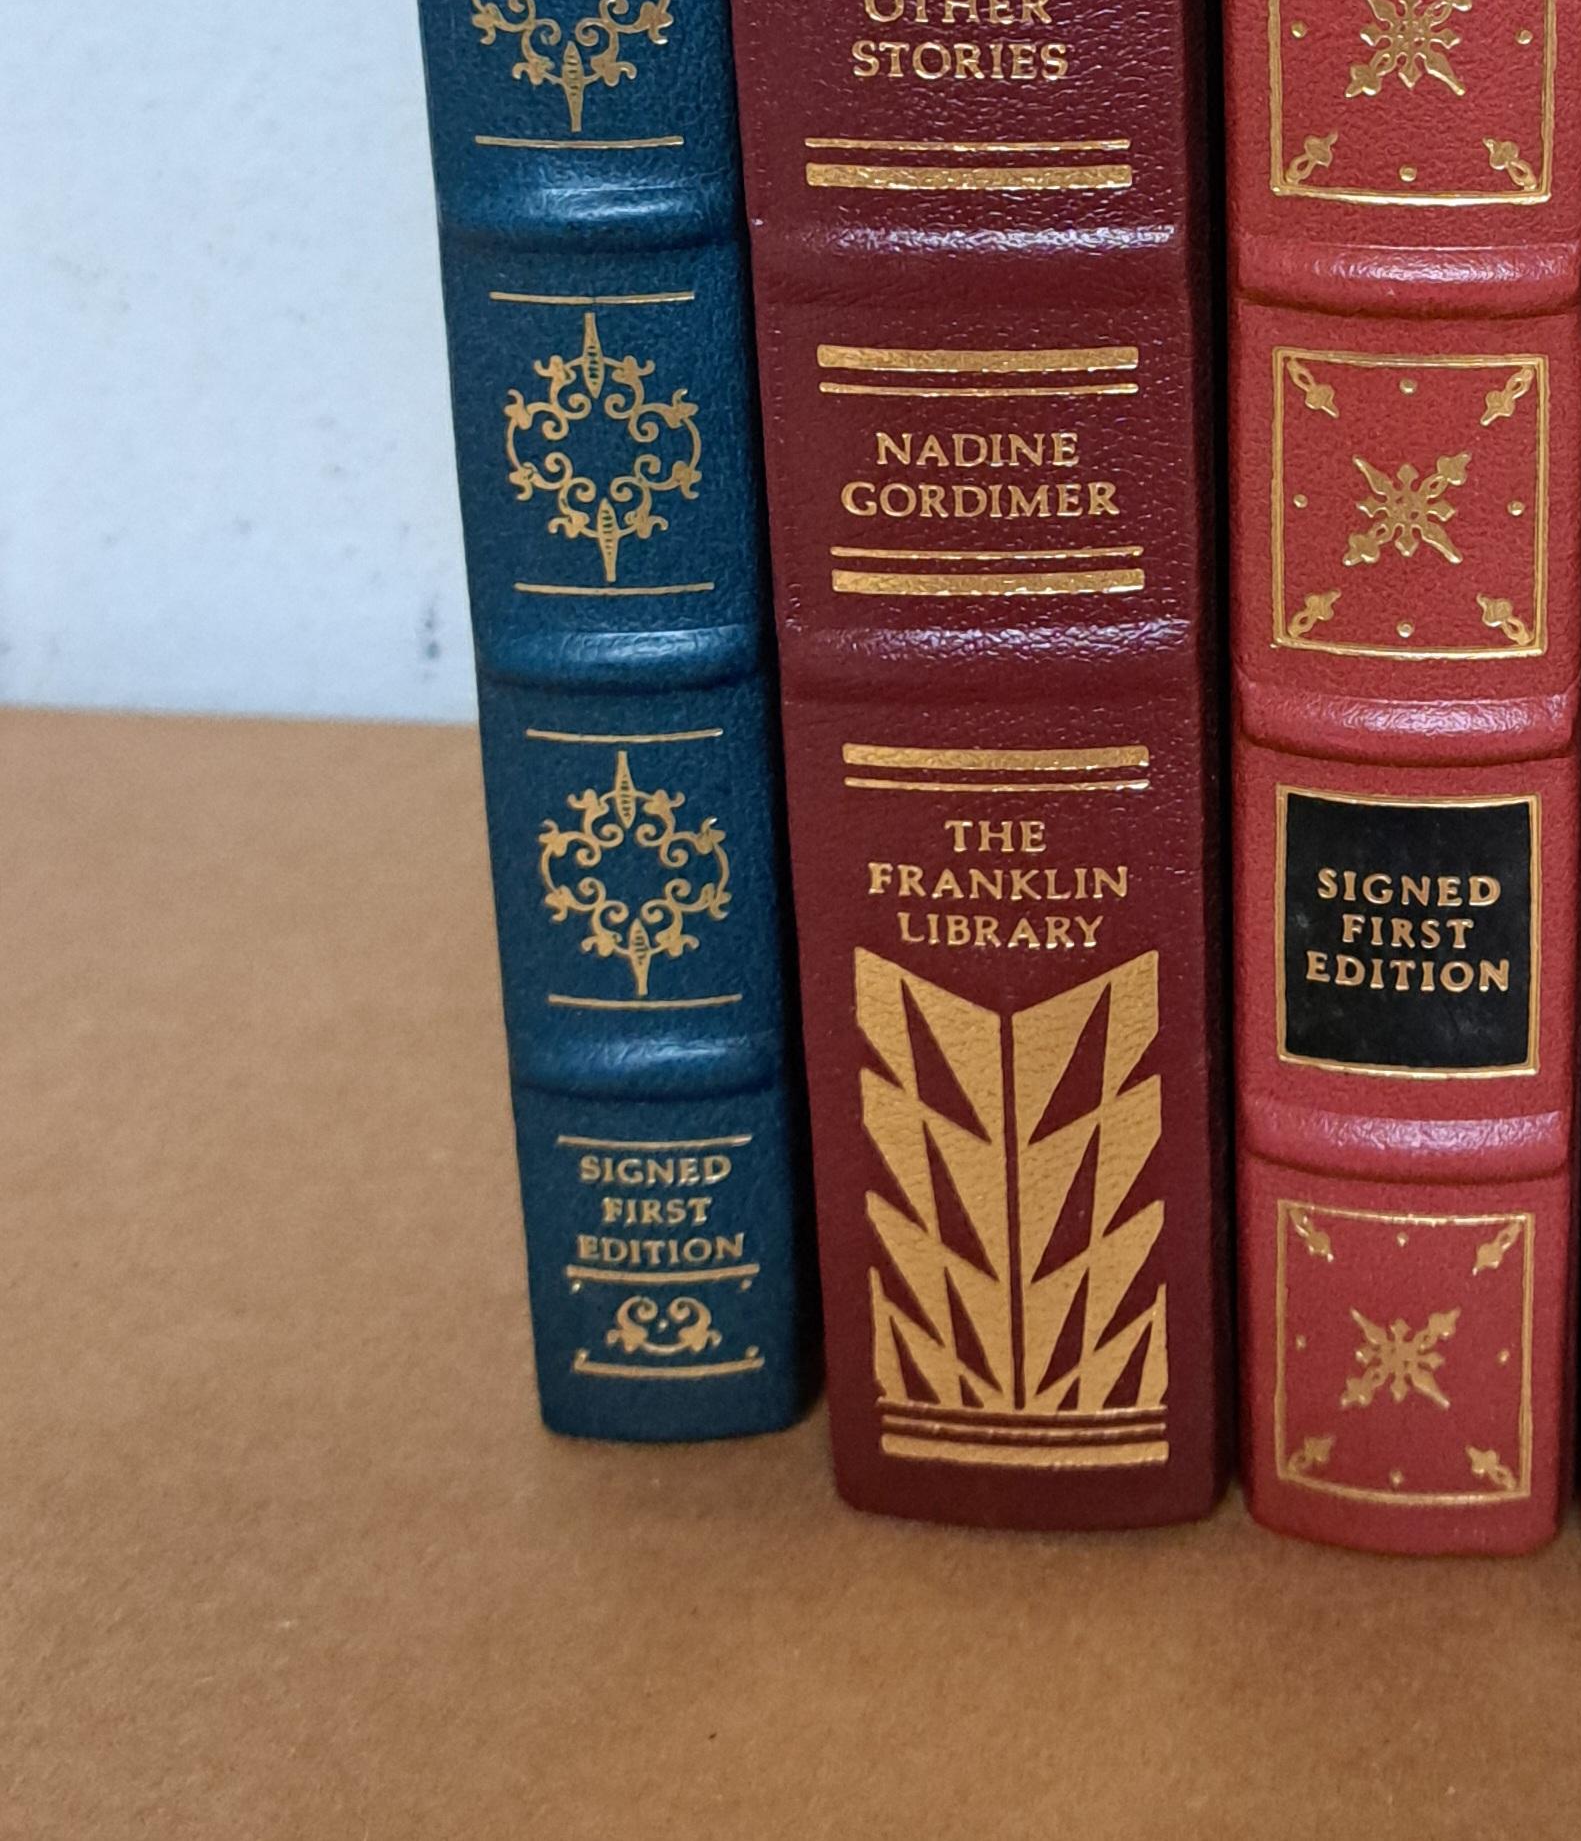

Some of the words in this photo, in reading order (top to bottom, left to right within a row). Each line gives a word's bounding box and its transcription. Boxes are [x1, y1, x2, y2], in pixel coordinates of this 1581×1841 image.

[851, 39, 1069, 81] STORIES
[875, 431, 1080, 468] NADINE
[840, 480, 1121, 519] GORDIMER
[944, 820, 1047, 853] THE
[867, 861, 1129, 901] FRANKLIN
[1317, 867, 1501, 907] SIGNED
[897, 911, 1104, 949] LIBRARY
[1342, 913, 1475, 949] FIRST
[1305, 950, 1510, 993] EDITION
[578, 1154, 732, 1186] SIGNED
[601, 1196, 713, 1226] FIRST
[576, 1231, 745, 1266] EDITION
